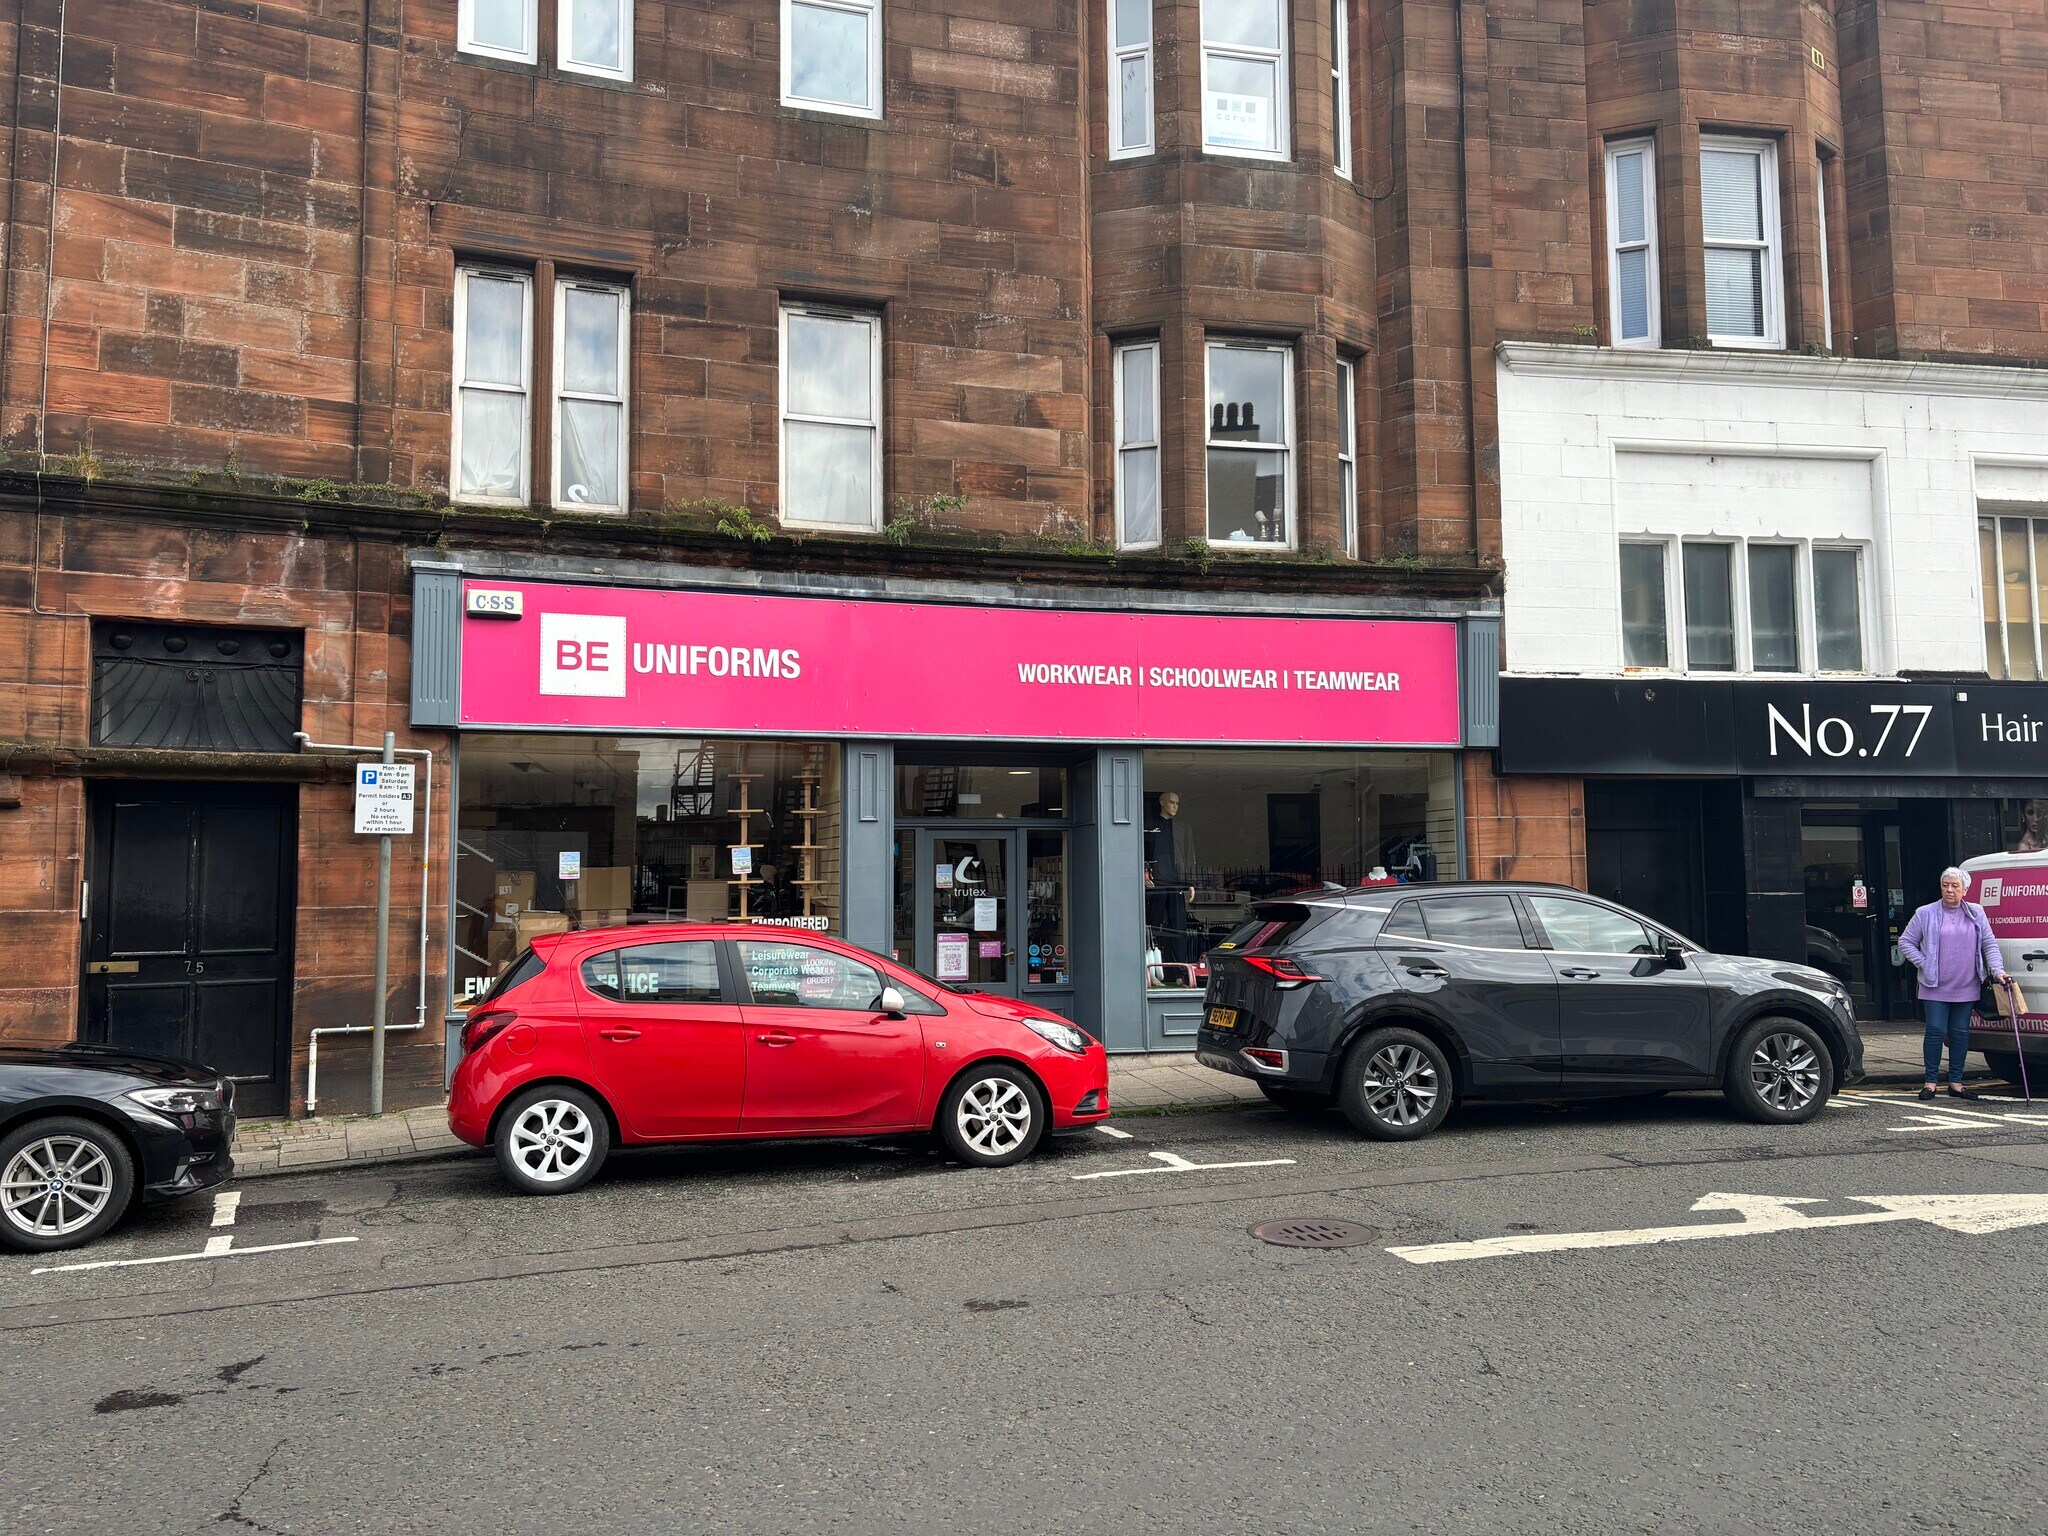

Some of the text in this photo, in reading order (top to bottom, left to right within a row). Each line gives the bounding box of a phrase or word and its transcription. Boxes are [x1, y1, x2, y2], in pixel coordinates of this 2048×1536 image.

[556, 639, 801, 680] BE UNIFORMS
[1017, 663, 1132, 686] WORKWEAR
[1150, 667, 1278, 689] SCHOOLWEAR
[1293, 670, 1400, 691] TEAMWEAR
[1767, 702, 1933, 758] No.77
[1981, 712, 2043, 742] Hair
[953, 887, 987, 897] trutex
[1984, 886, 1998, 898] BE
[1994, 916, 2031, 924] SCHOOLWEAR
[752, 950, 810, 961] Leisurewear
[184, 960, 204, 974] 75
[752, 964, 824, 978] Corporate Wear
[751, 980, 801, 991] Teamwear
[806, 976, 834, 985] ORDER?
